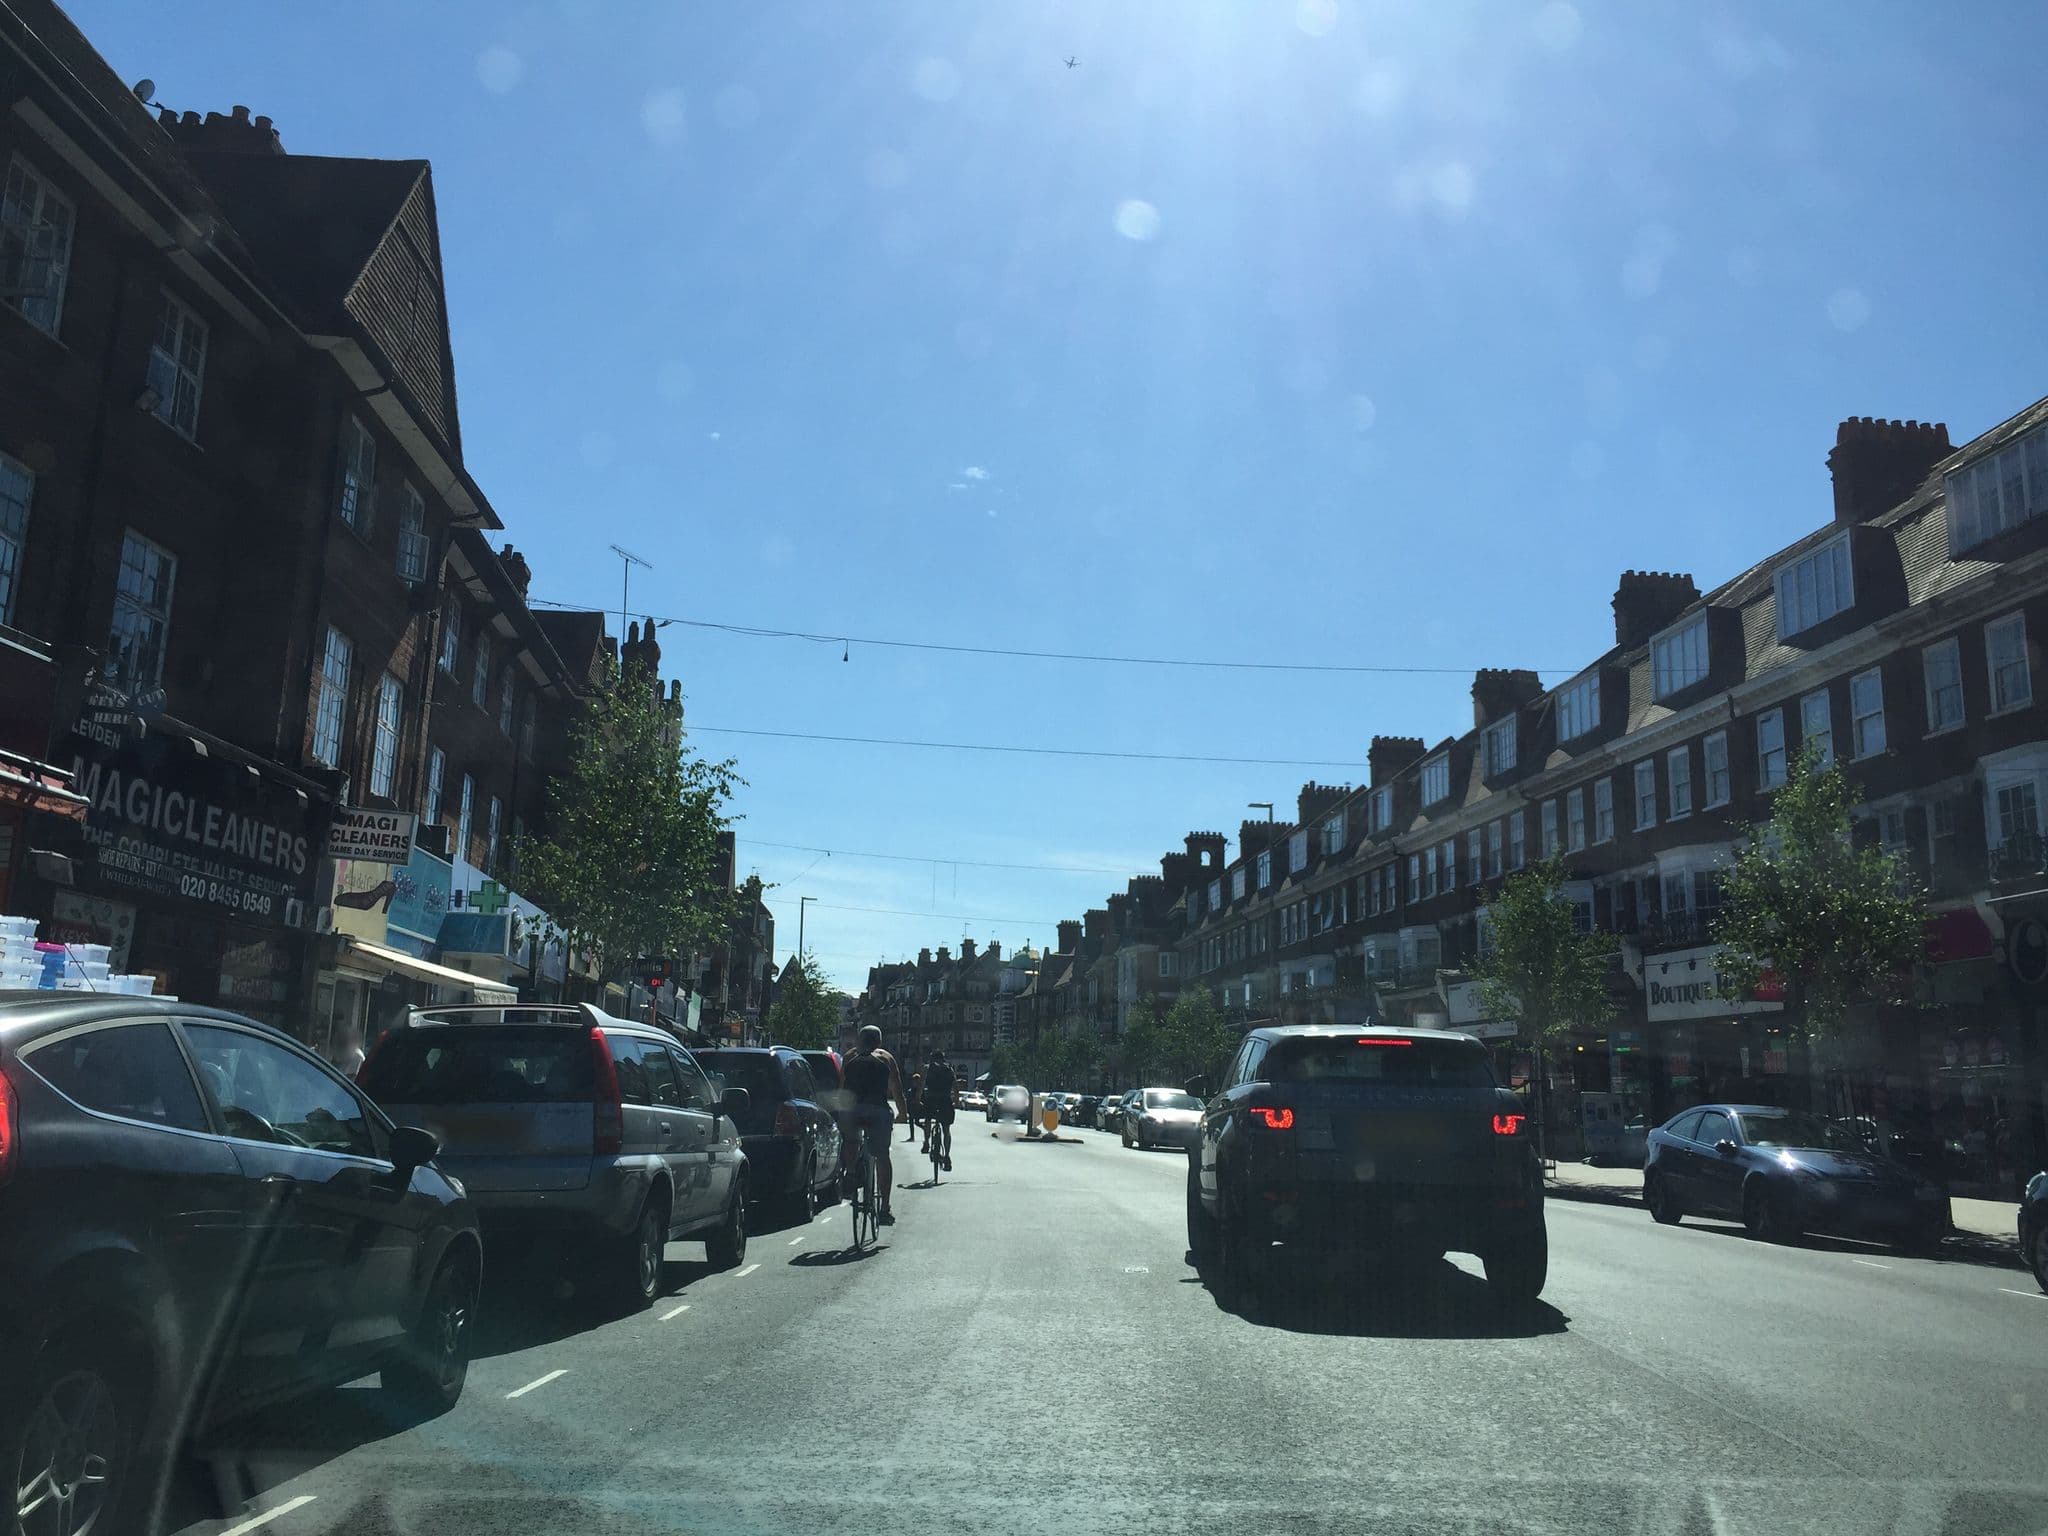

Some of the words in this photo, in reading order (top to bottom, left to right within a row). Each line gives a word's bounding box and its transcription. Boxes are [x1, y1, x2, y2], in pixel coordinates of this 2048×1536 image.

[75, 754, 308, 875] MAGICLEANERS
[329, 828, 409, 850] CLEANERS
[354, 847, 371, 856] DAY
[181, 873, 206, 900] 020
[207, 881, 241, 908] 8455
[242, 890, 273, 916] 0549
[1649, 980, 1713, 1006] BOUTIQUE
